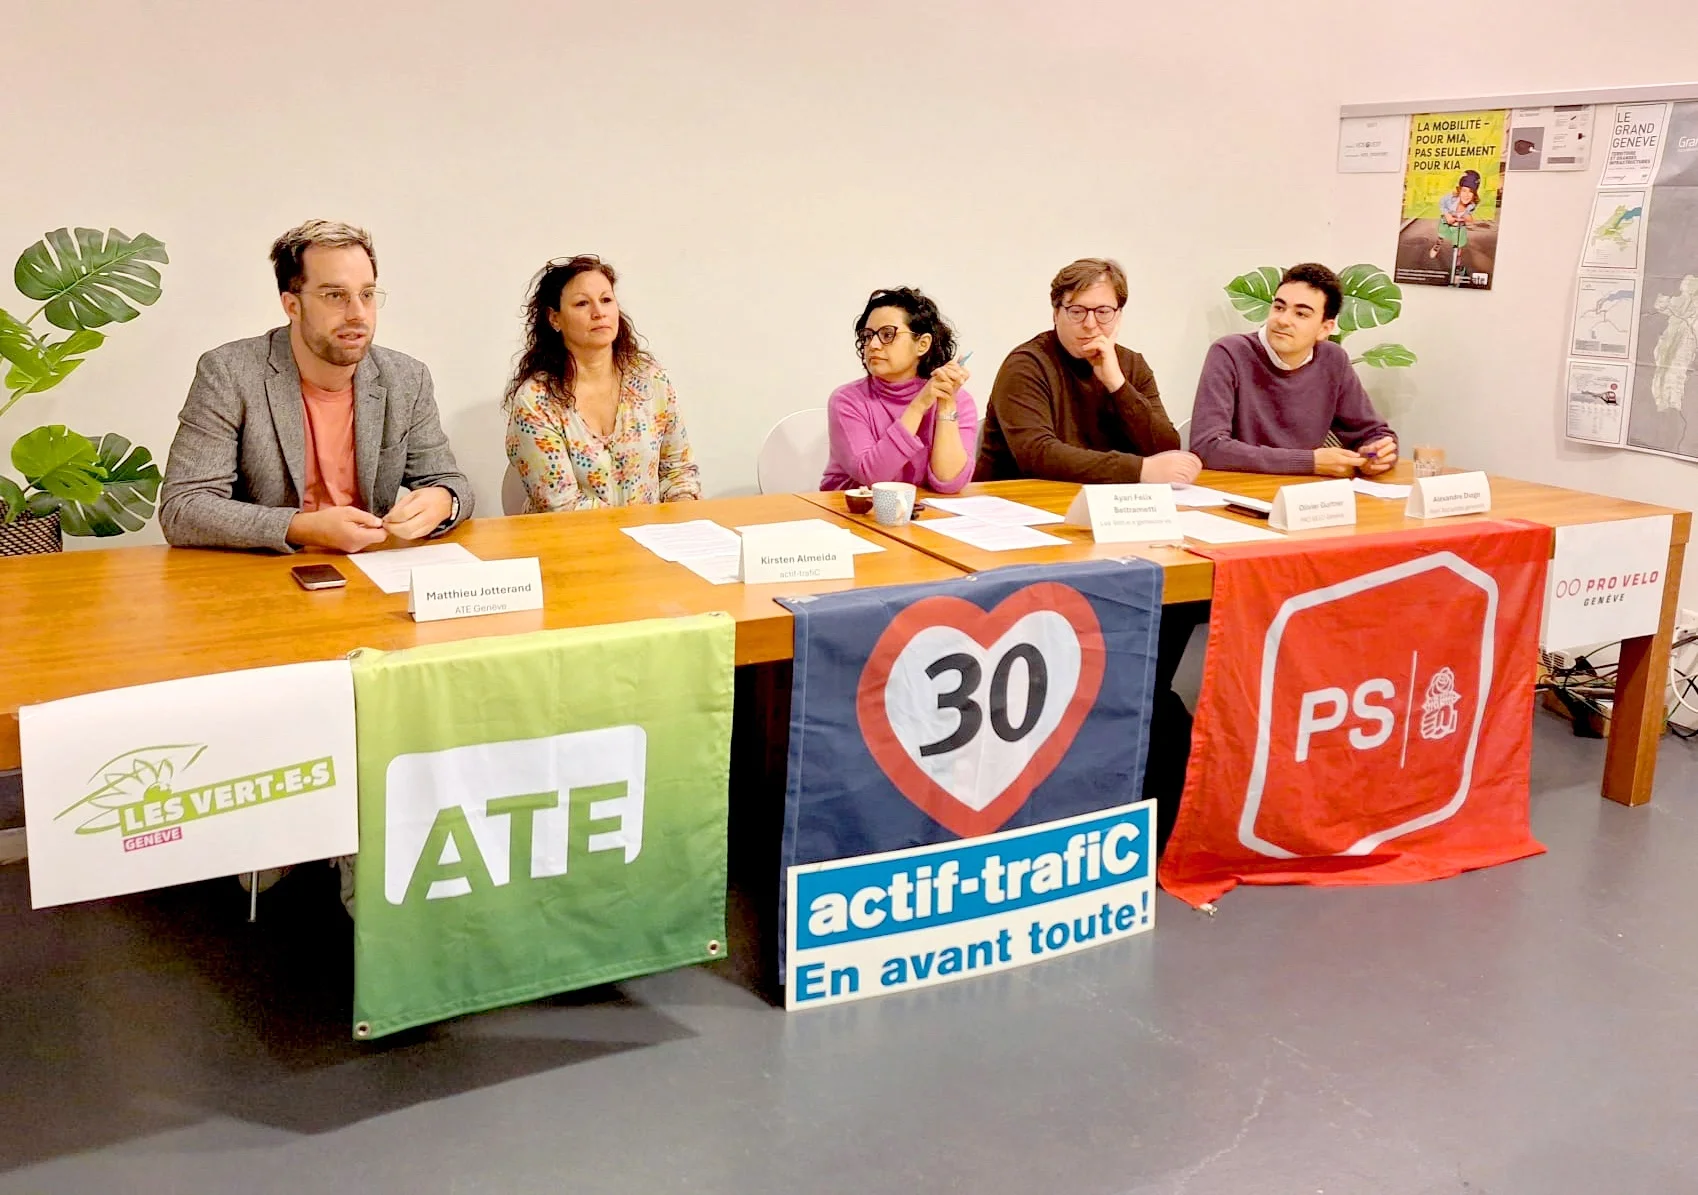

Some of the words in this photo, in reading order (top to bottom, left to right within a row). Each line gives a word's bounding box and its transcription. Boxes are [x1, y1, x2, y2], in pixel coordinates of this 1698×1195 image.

[1417, 122, 1430, 132] LA
[1432, 117, 1482, 131] MOBILITÉ
[1617, 112, 1632, 123] LE
[1614, 123, 1655, 136] GRAND
[1416, 134, 1443, 144] POUR
[1446, 133, 1470, 145] MIA,
[1414, 148, 1432, 158] PAS
[1434, 146, 1496, 157] SEULEMENT
[1413, 160, 1441, 170] POUR
[1443, 160, 1461, 170] KIA
[760, 555, 795, 565] Kirsten
[796, 553, 837, 564] Almeida
[1586, 576, 1617, 592] PRO
[1622, 570, 1659, 587] VELO
[426, 588, 477, 601] Matthieu
[480, 583, 532, 597] Jotterand
[454, 605, 472, 615] ATE
[473, 602, 507, 613] Genève
[919, 643, 1048, 758] 30
[1294, 677, 1396, 762] PS
[123, 797, 185, 832] LES
[402, 780, 628, 904] ATE
[808, 821, 1141, 937] actif-trafiC
[795, 962, 859, 1002] En
[880, 929, 1012, 988] avant
[1028, 890, 1149, 954] toute!
